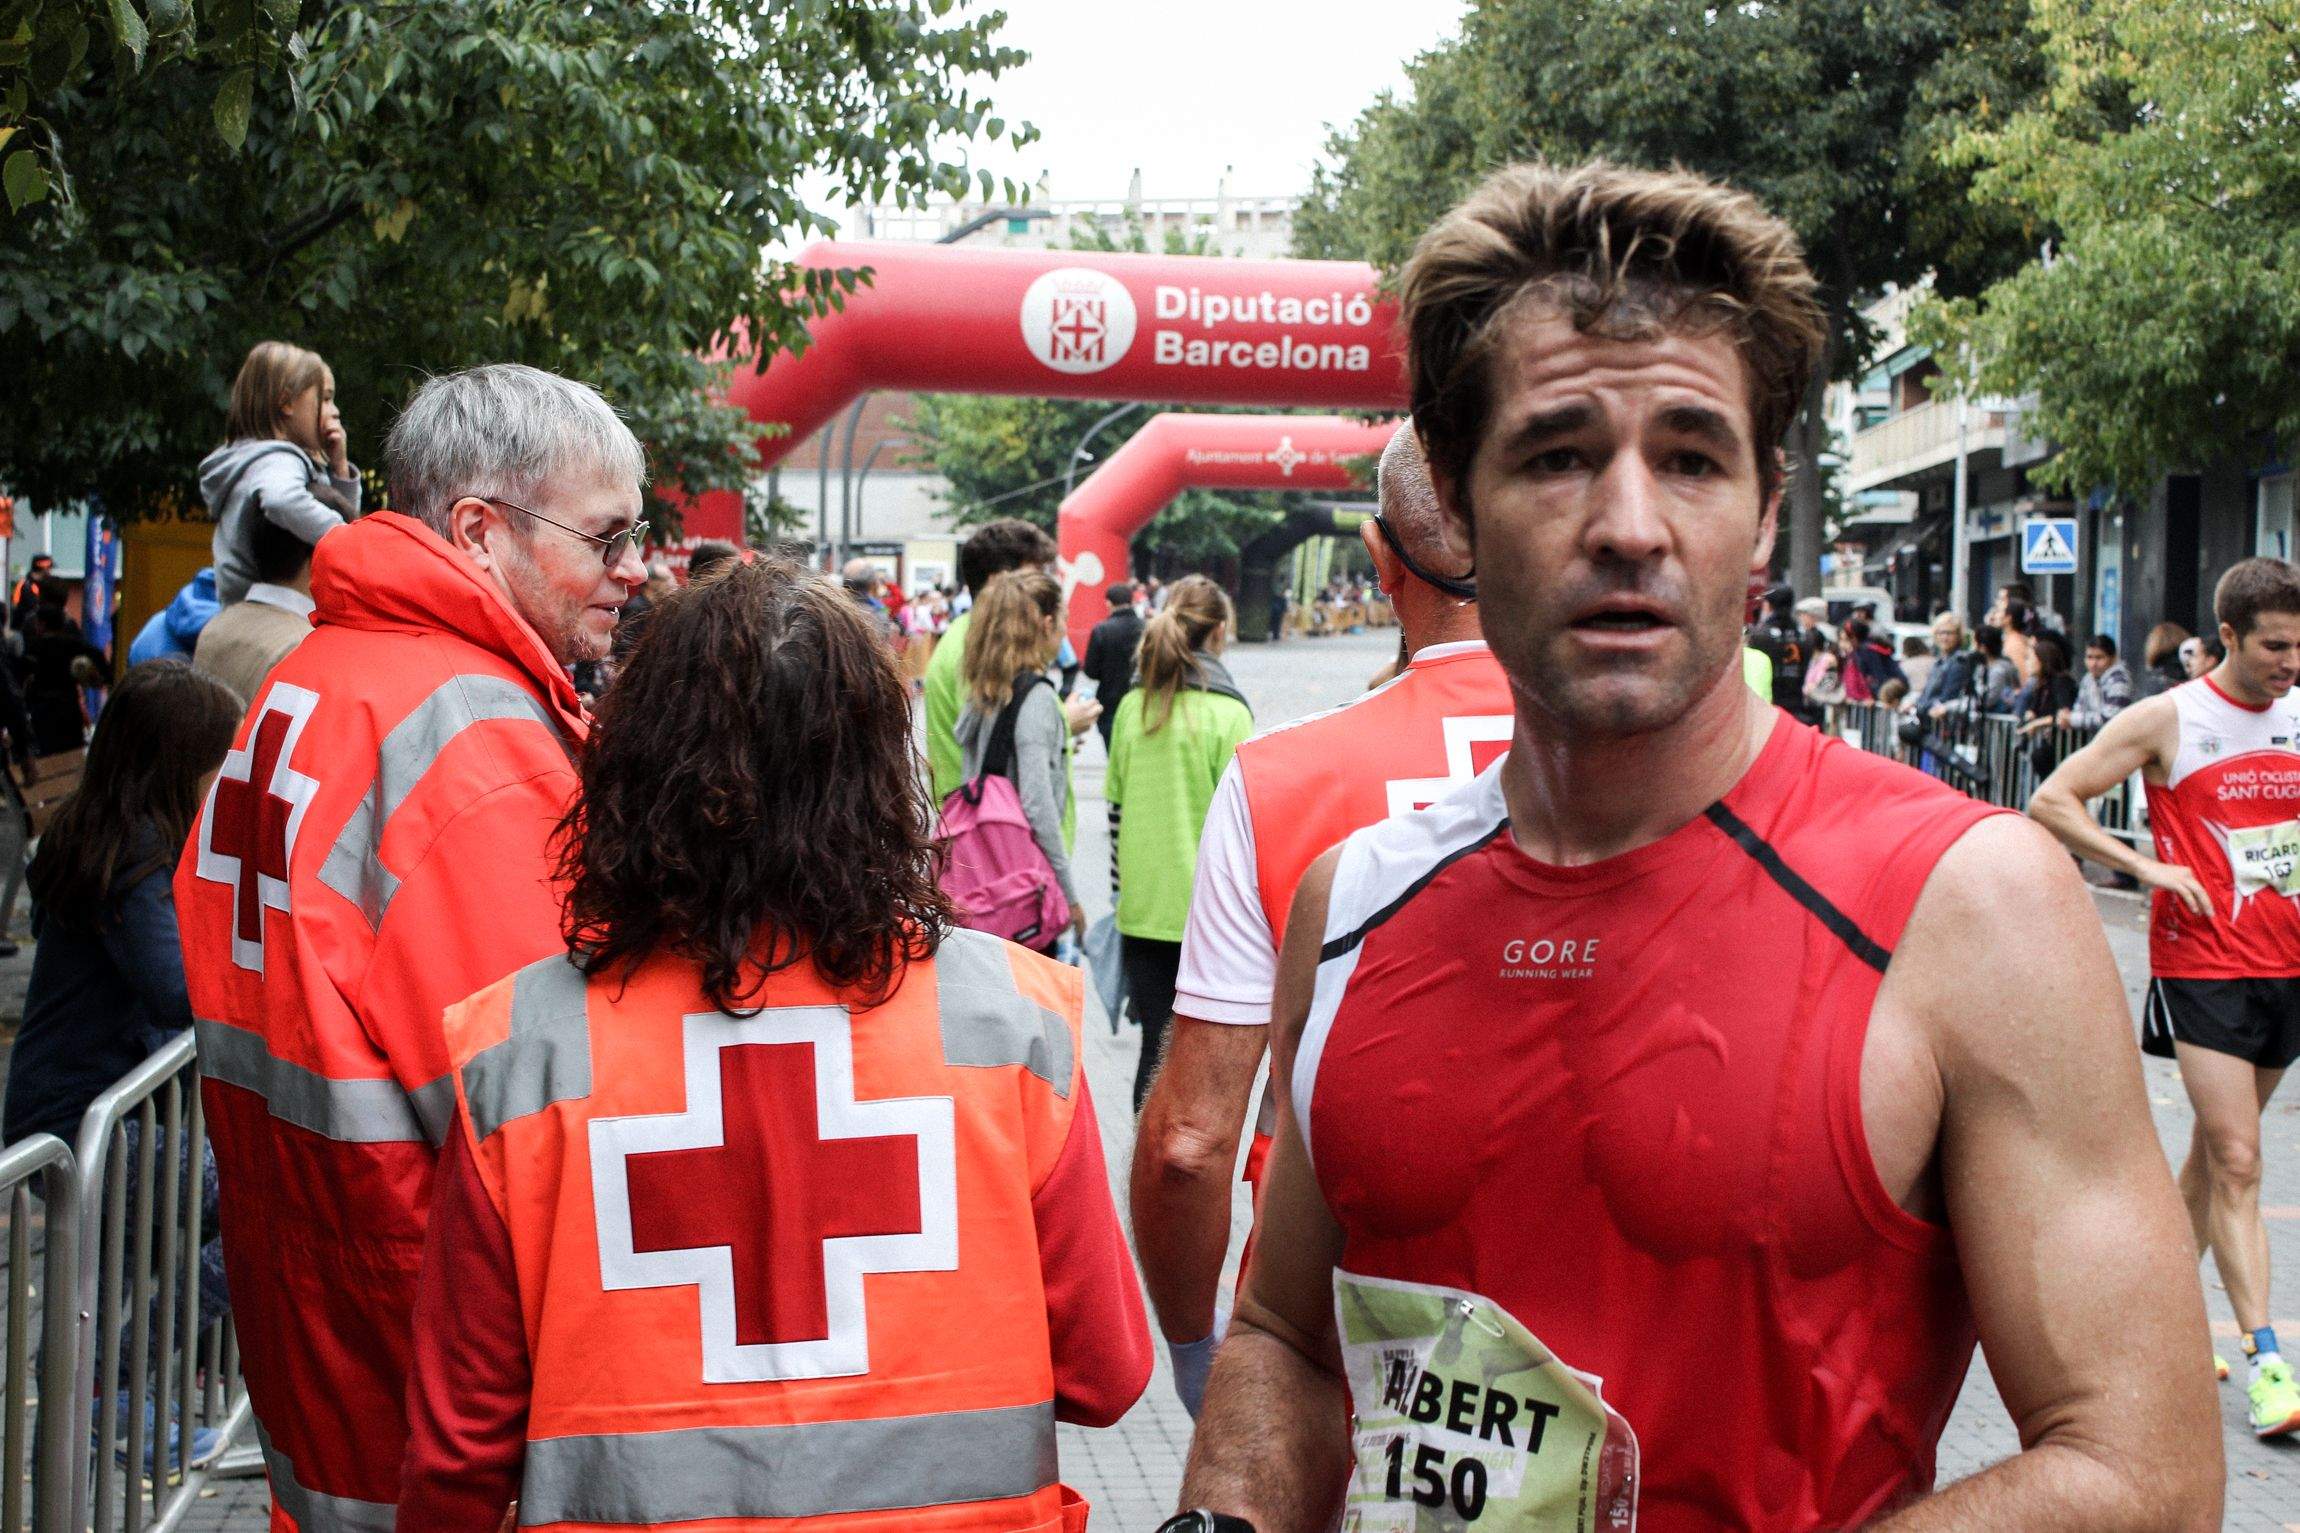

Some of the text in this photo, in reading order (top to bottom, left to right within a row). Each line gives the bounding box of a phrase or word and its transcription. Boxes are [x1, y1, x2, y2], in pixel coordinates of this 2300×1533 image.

[1155, 285, 1372, 329] Diputació
[1155, 330, 1370, 371] Barcelona
[2222, 769, 2257, 785] UNIÓ
[2217, 784, 2259, 801] SANT
[1503, 938, 1600, 964] GORE
[1500, 968, 1594, 979] RUNNING WEAR
[1385, 1436, 1487, 1522] 150
